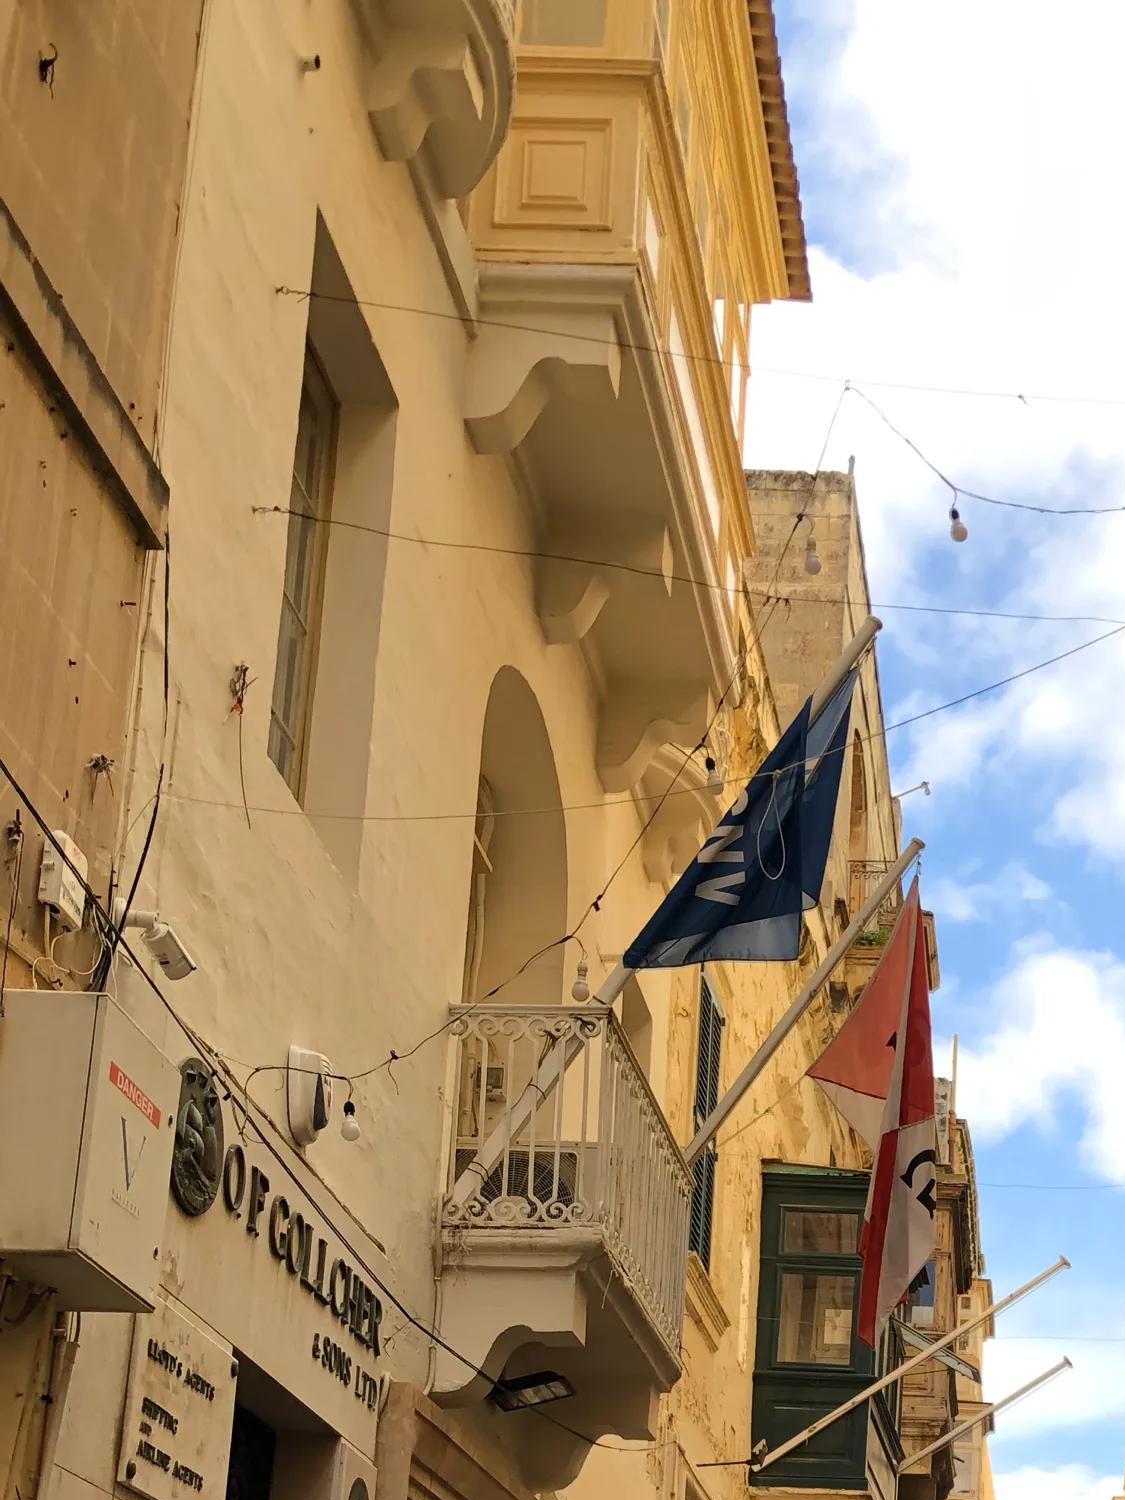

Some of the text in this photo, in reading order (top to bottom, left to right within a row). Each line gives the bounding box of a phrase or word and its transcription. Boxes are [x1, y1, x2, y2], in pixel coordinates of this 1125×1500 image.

[116, 1069, 155, 1121] DANGER
[269, 1194, 382, 1357] GOLLCHER
[147, 1337, 216, 1402] LLOYD'S AGENTS
[312, 1332, 322, 1360] &
[321, 1335, 353, 1386] SONS
[172, 1460, 204, 1493] AGENTS
